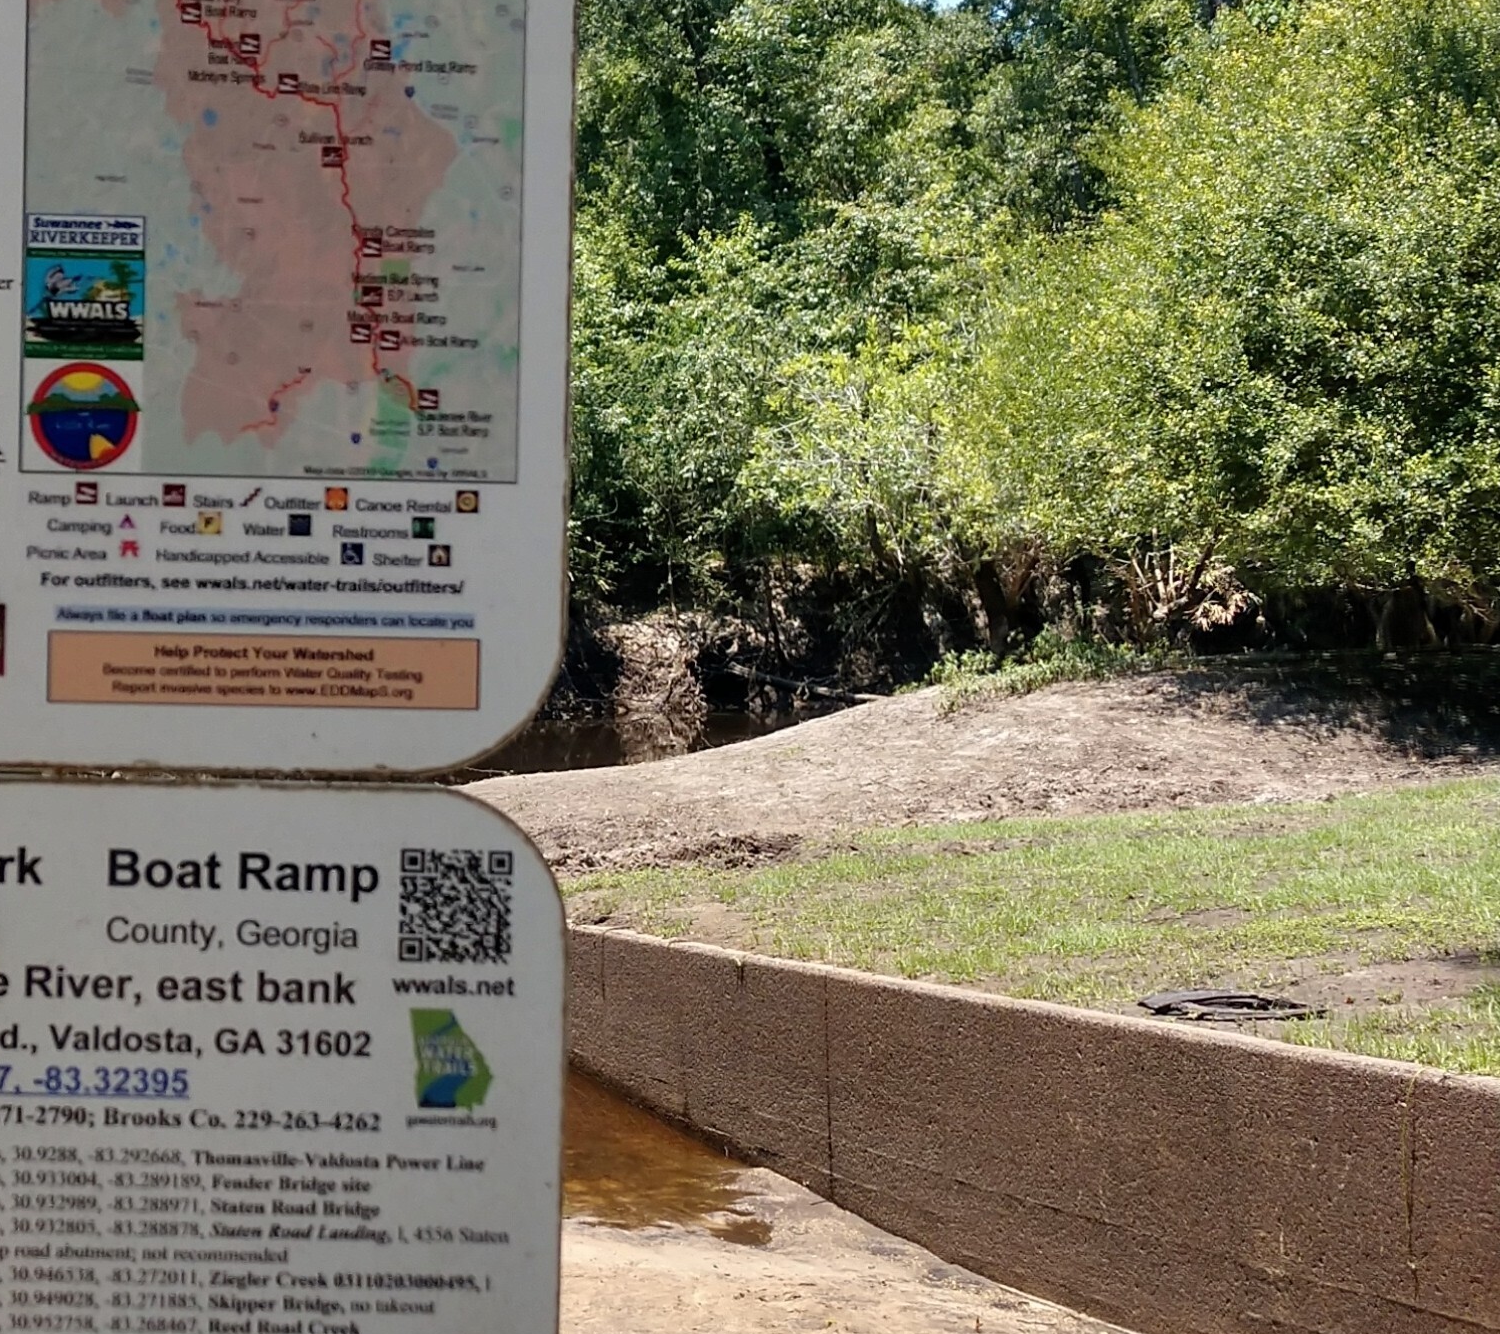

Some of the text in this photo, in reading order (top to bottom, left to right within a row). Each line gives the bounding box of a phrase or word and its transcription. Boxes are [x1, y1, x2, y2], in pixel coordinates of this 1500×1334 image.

[33, 217, 102, 229] Suwannee
[30, 230, 139, 246] RIVERKEEPER
[50, 301, 128, 320] WWALS
[28, 491, 72, 508] Ramp
[105, 492, 159, 508] Launch
[40, 571, 71, 587] For
[161, 577, 192, 590] see
[193, 645, 249, 660] Protect
[252, 646, 289, 661] Your
[292, 647, 375, 662] Watershed
[108, 848, 222, 890] Boat
[238, 852, 379, 903] Ramp
[106, 915, 224, 952] County,
[236, 919, 359, 955] Georgia
[24, 964, 142, 1006] River,
[157, 971, 244, 1003] east
[257, 970, 356, 1005] bank
[391, 975, 516, 997] wwals.net
[48, 1023, 202, 1059] Valdosta,
[214, 1028, 266, 1055] GA
[276, 1029, 371, 1058] 31602
[33, 1066, 190, 1098] -83.32395
[103, 1106, 182, 1128] Brooks
[188, 1109, 227, 1129] Co.
[234, 1109, 381, 1133] 229-263-4262
